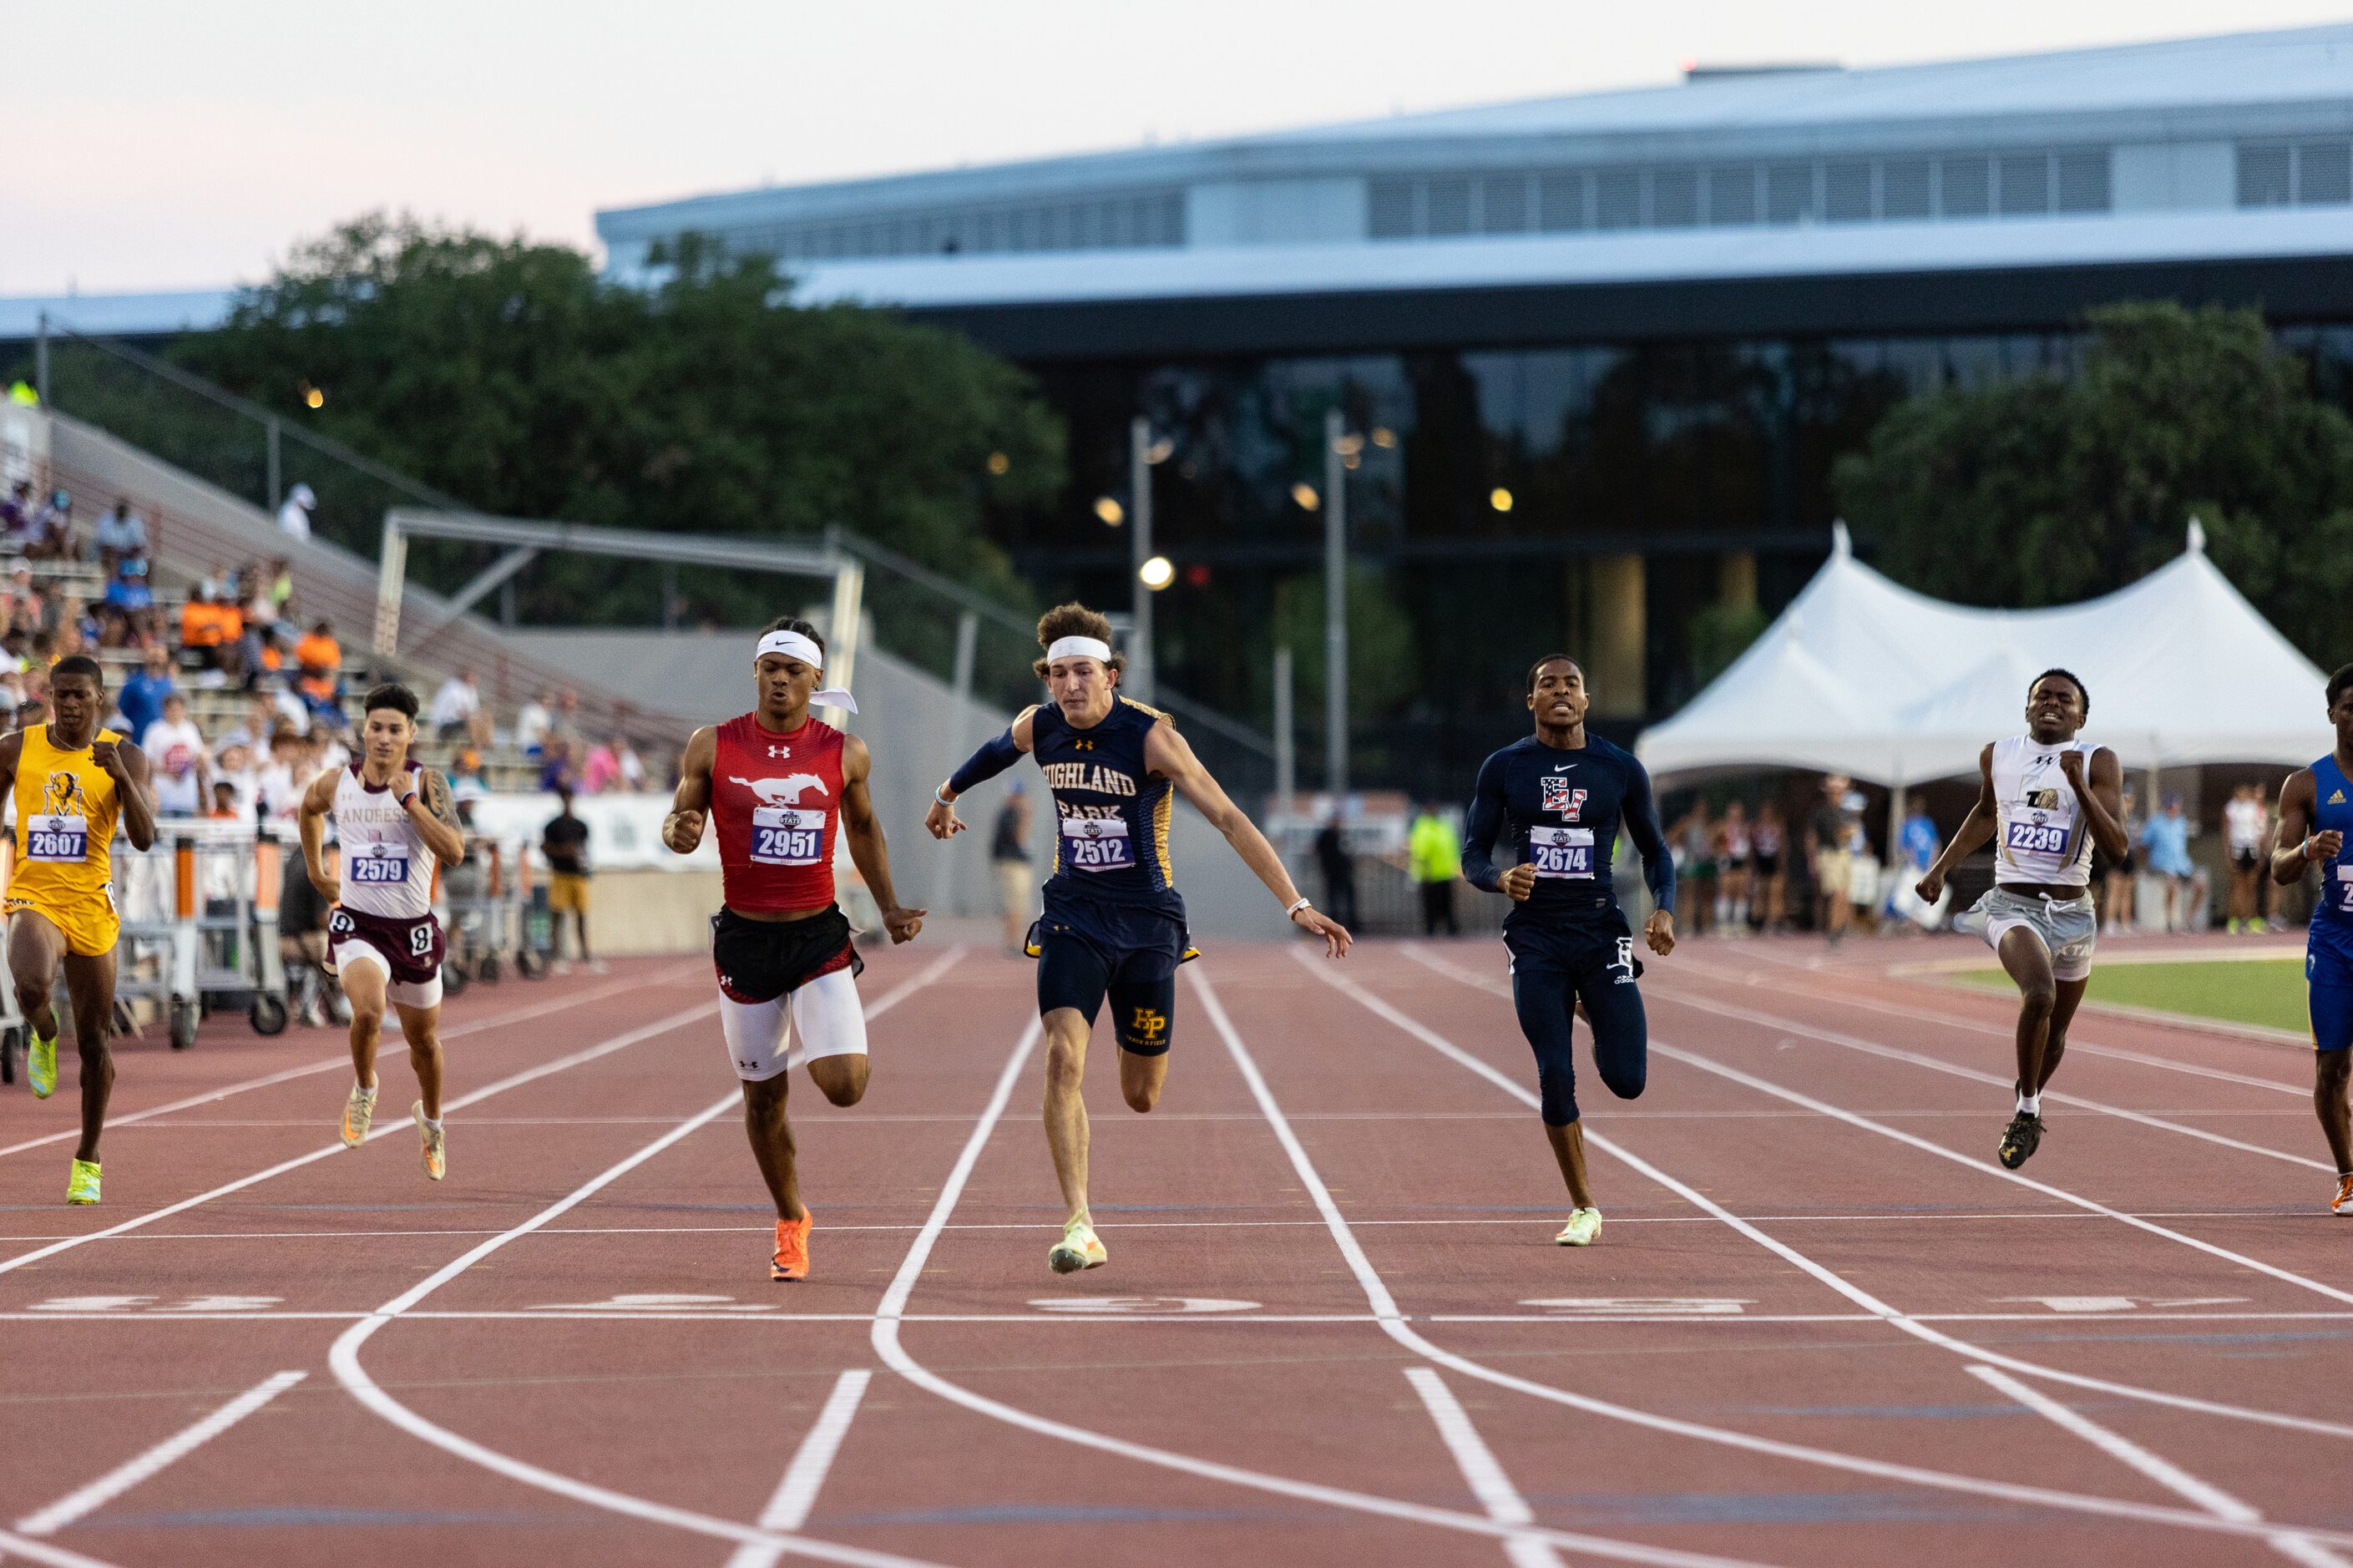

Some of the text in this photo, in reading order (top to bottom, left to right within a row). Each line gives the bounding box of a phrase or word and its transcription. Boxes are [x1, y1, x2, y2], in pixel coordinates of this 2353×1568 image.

[1043, 763, 1136, 796] HIGHLAND
[1056, 799, 1125, 820] PARK
[1541, 777, 1586, 822] EV
[33, 833, 81, 855] 2607
[758, 829, 816, 857] 2951
[2011, 824, 2062, 851] 2239
[1073, 839, 1126, 864] 2512
[1536, 846, 1586, 871] 2674
[357, 858, 402, 881] 2579
[333, 914, 351, 932] 9
[414, 927, 428, 951] 8
[1132, 1008, 1166, 1038] HP
